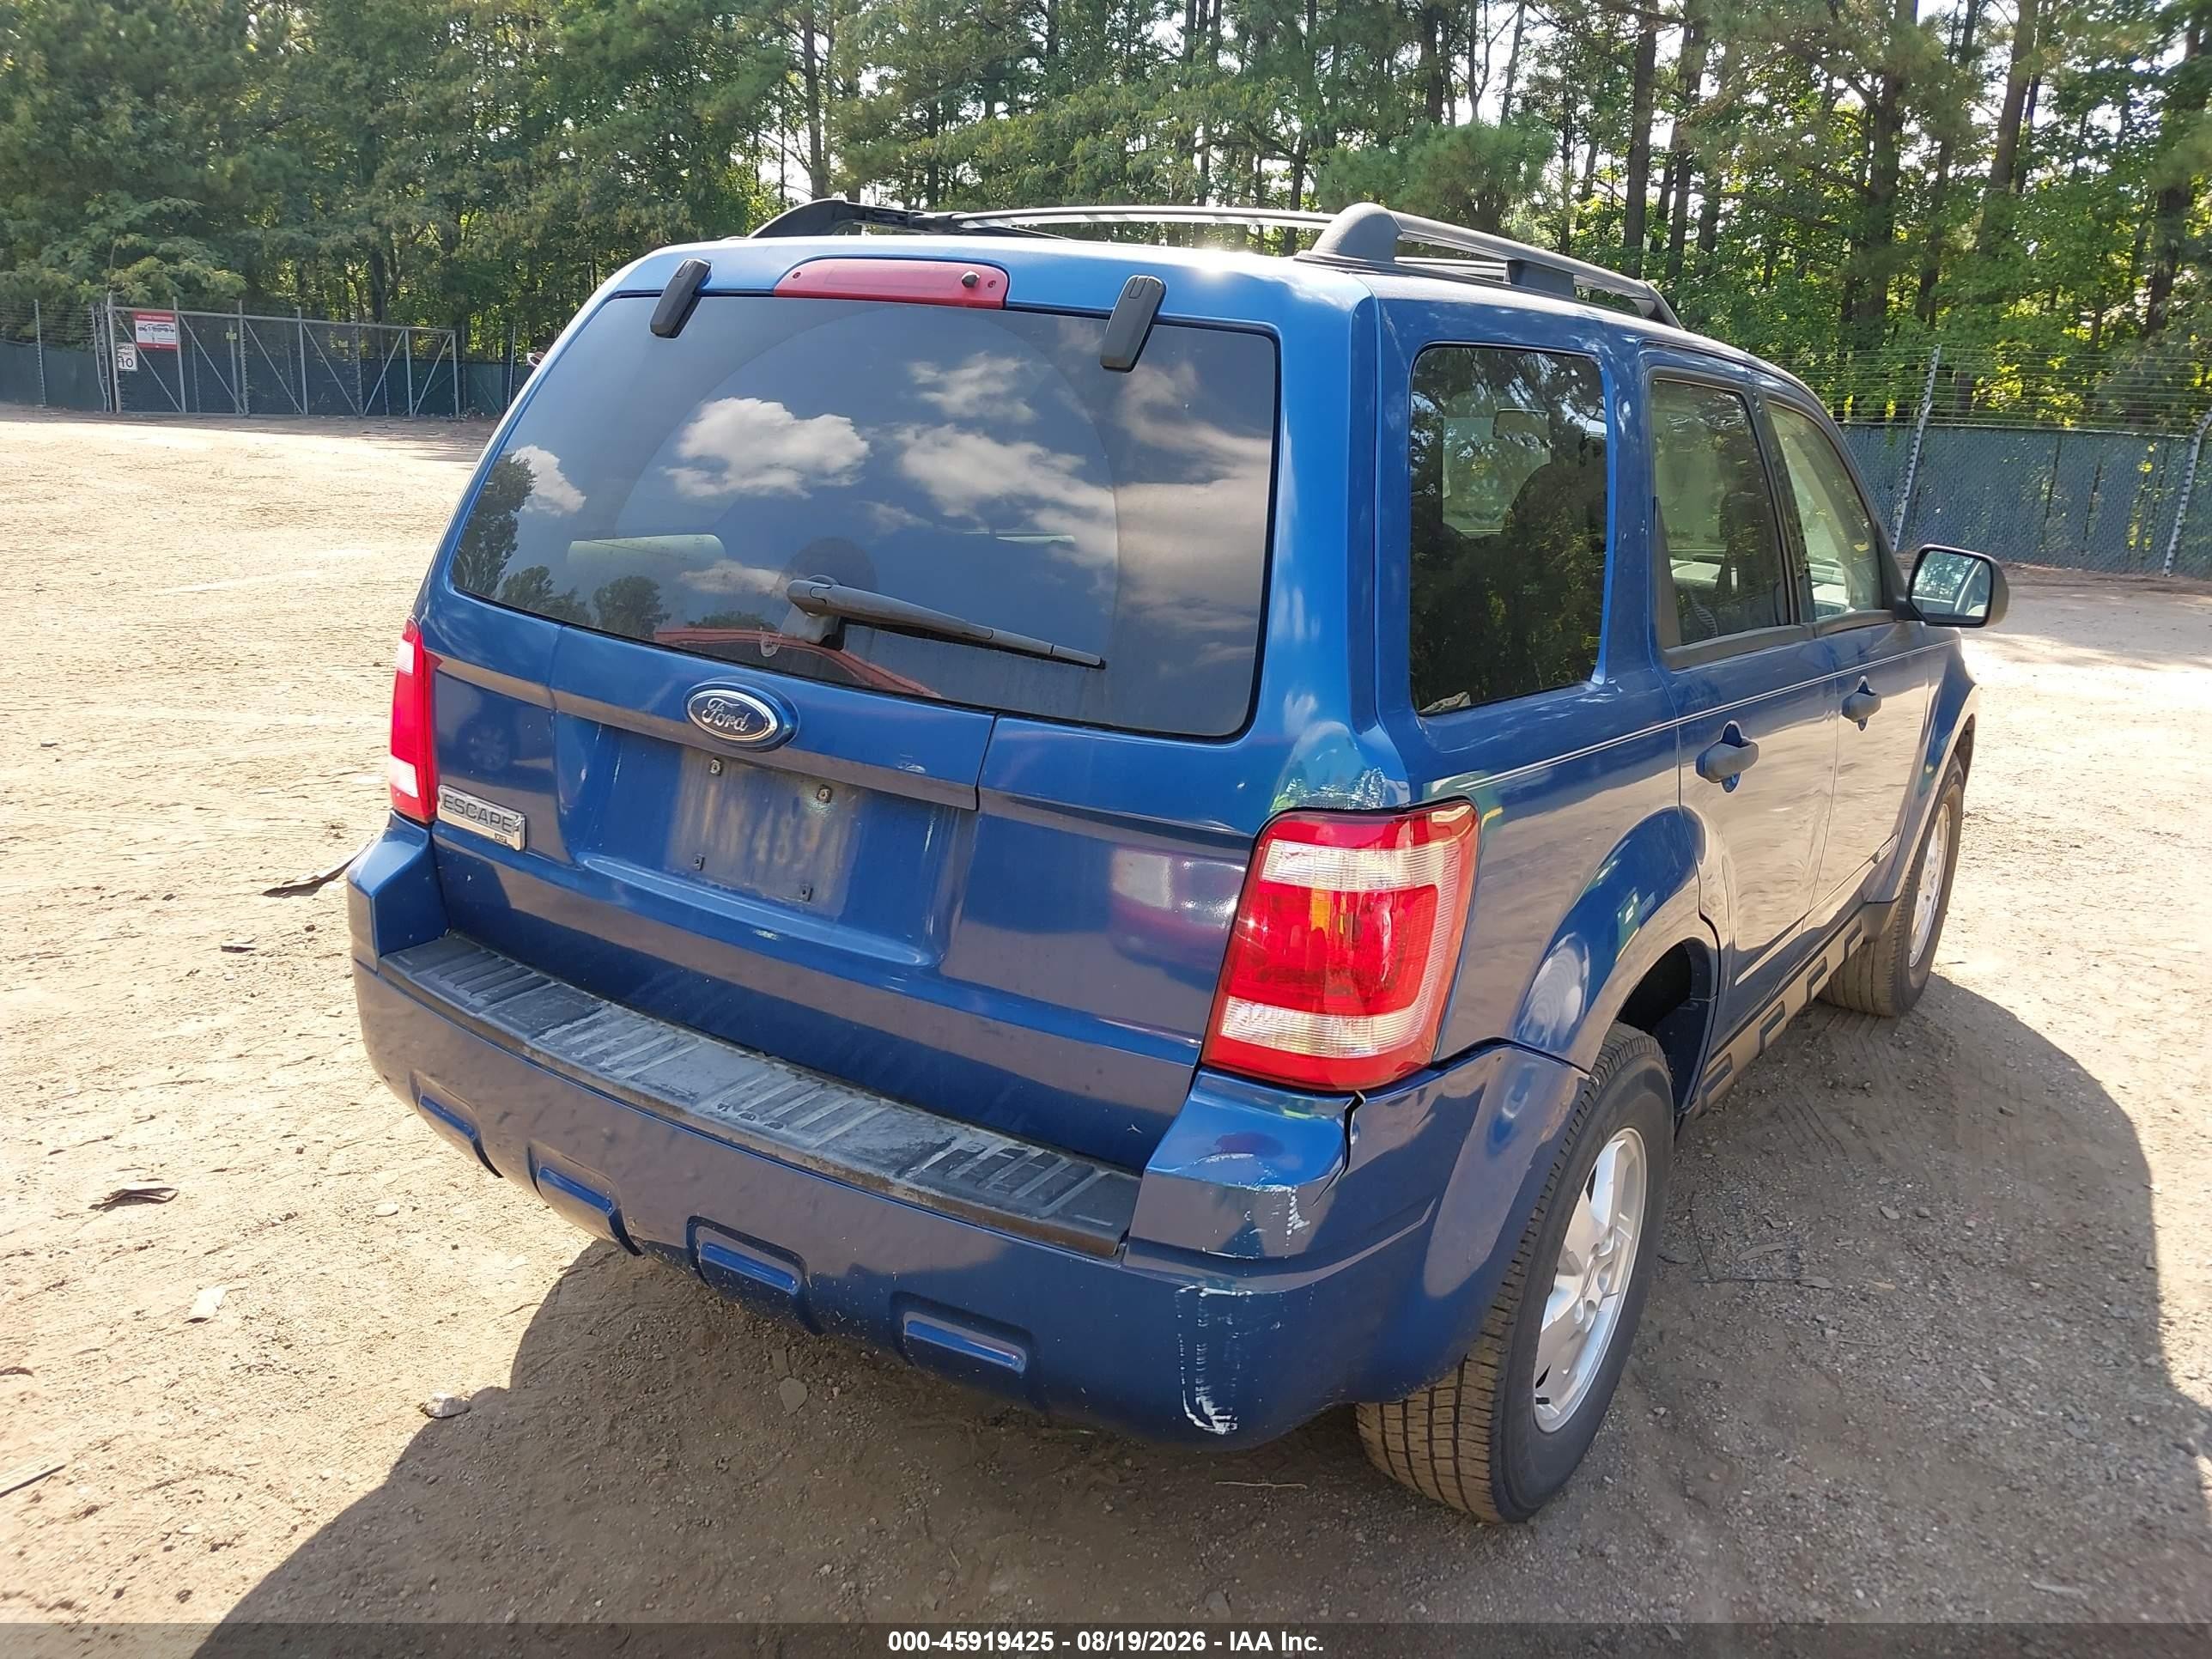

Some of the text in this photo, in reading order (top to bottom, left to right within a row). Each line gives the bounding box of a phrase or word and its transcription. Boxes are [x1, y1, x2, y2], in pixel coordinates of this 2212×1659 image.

[121, 358, 133, 368] 10
[702, 697, 750, 732] Ford
[443, 794, 514, 834] ESCAPE
